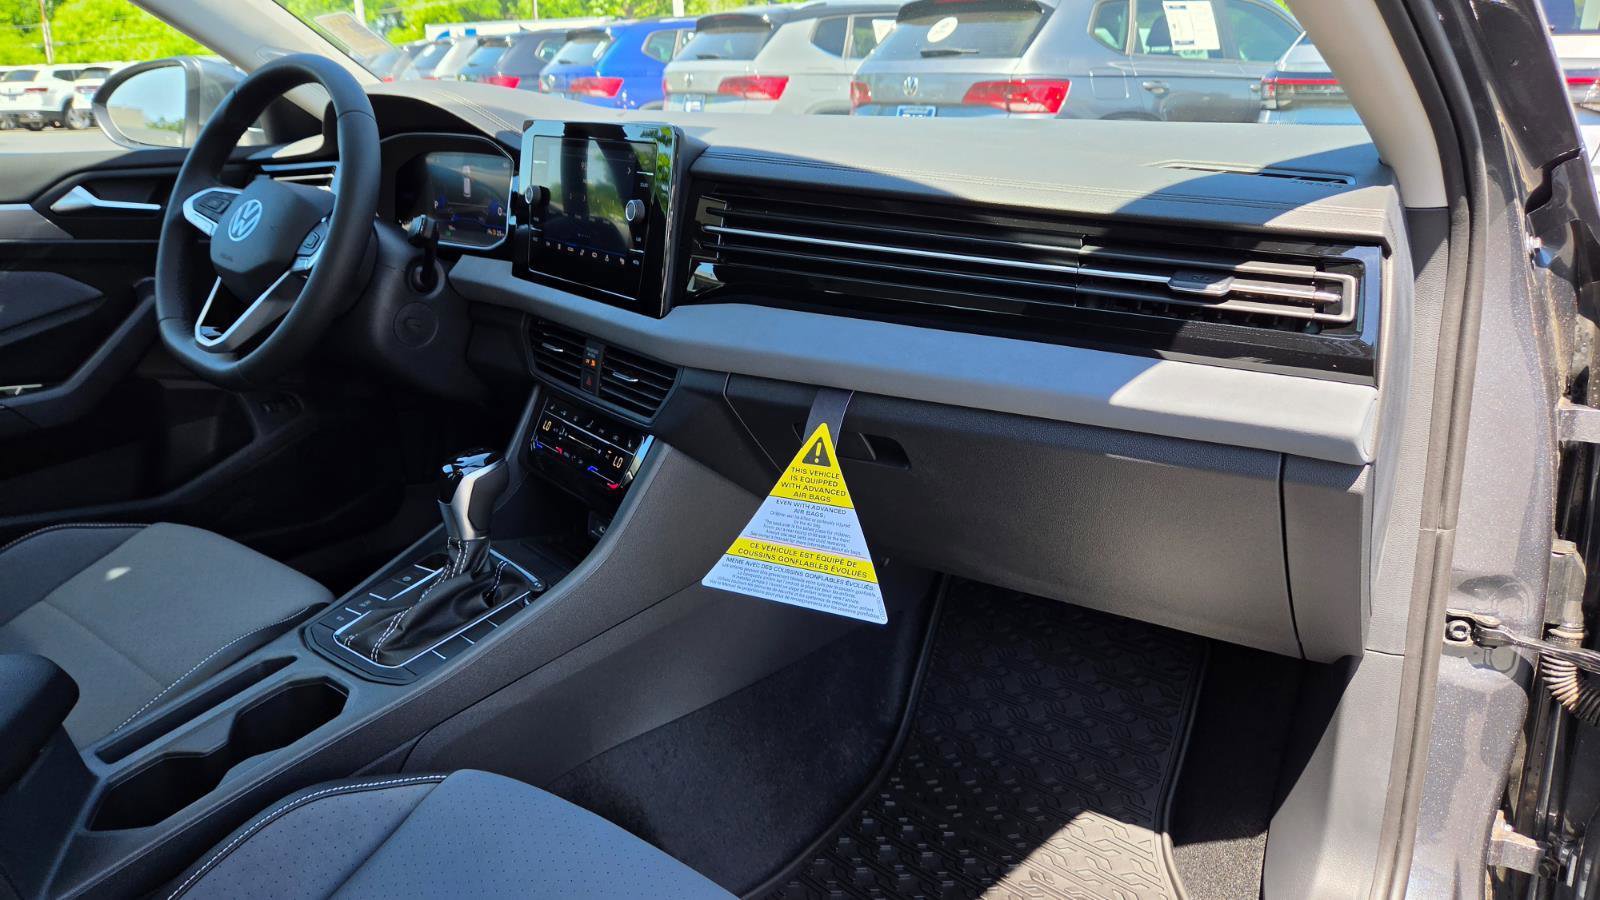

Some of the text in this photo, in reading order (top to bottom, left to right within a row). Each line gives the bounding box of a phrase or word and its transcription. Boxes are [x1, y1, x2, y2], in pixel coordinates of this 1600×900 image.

[810, 471, 840, 479] VEHICLE
[800, 476, 838, 487] EQUIPPED
[803, 485, 846, 496] ADVANCED
[809, 494, 831, 502] BAGS
[810, 505, 846, 515] ADVANCED
[738, 548, 776, 560] COUSSINS
[778, 556, 828, 570] GONFLABLES
[774, 566, 803, 576] COUSSINS
[805, 573, 844, 584] GONFLABLES
